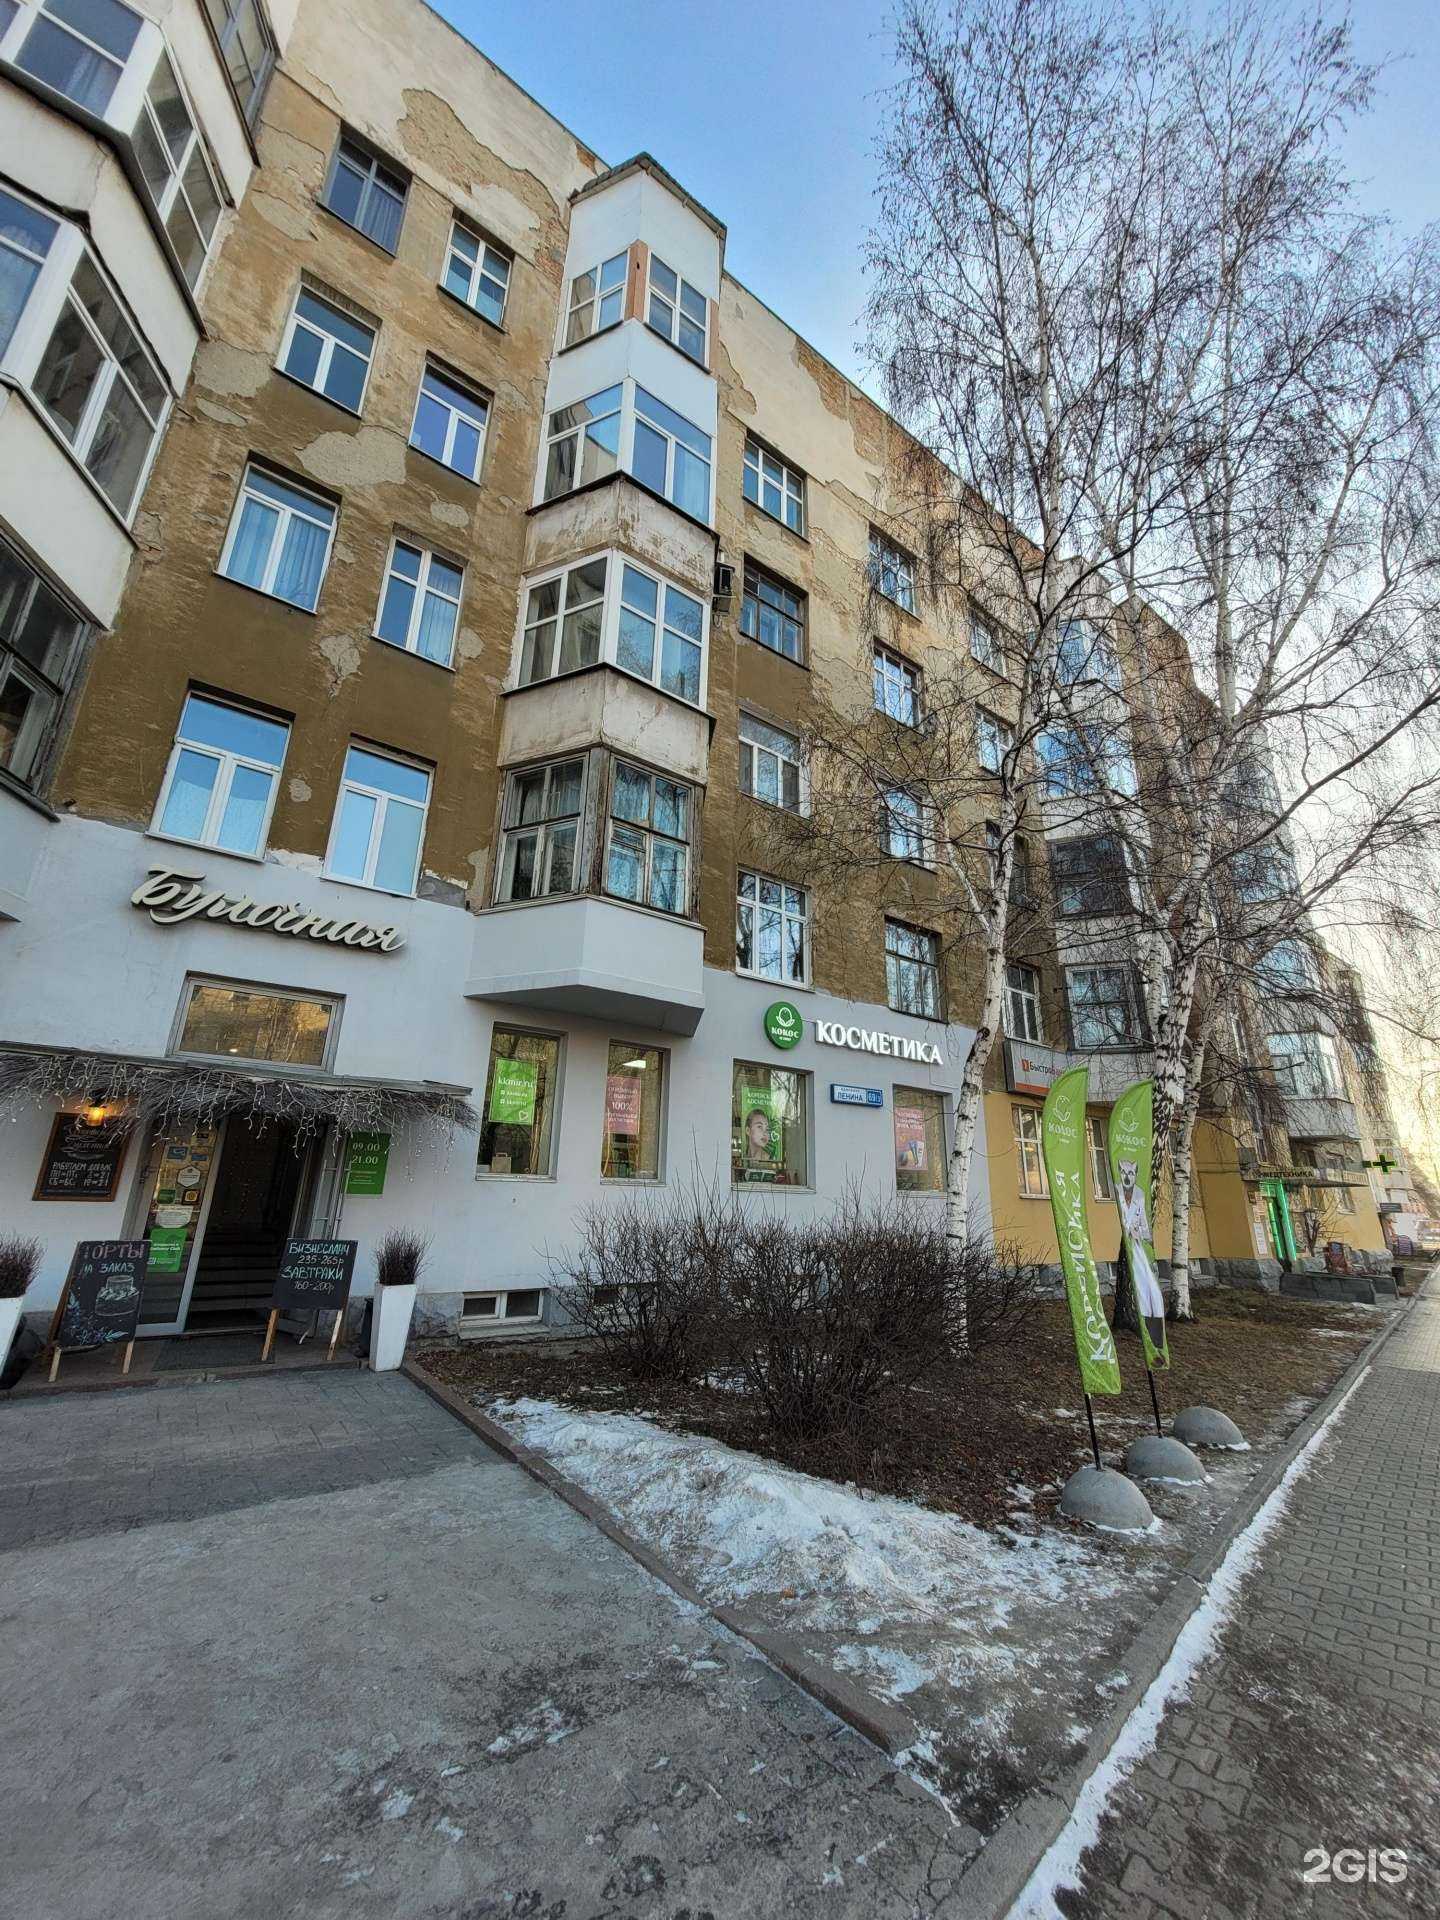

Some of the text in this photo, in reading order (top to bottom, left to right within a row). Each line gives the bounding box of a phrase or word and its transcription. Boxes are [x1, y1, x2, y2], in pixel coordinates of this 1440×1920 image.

[131, 864, 407, 952] Булочная
[816, 1019, 943, 1065] КОСМЕТИКА
[100, 1261, 136, 1274] ЗАКАЗ
[280, 1265, 345, 1281] ЗАВТРАКИ
